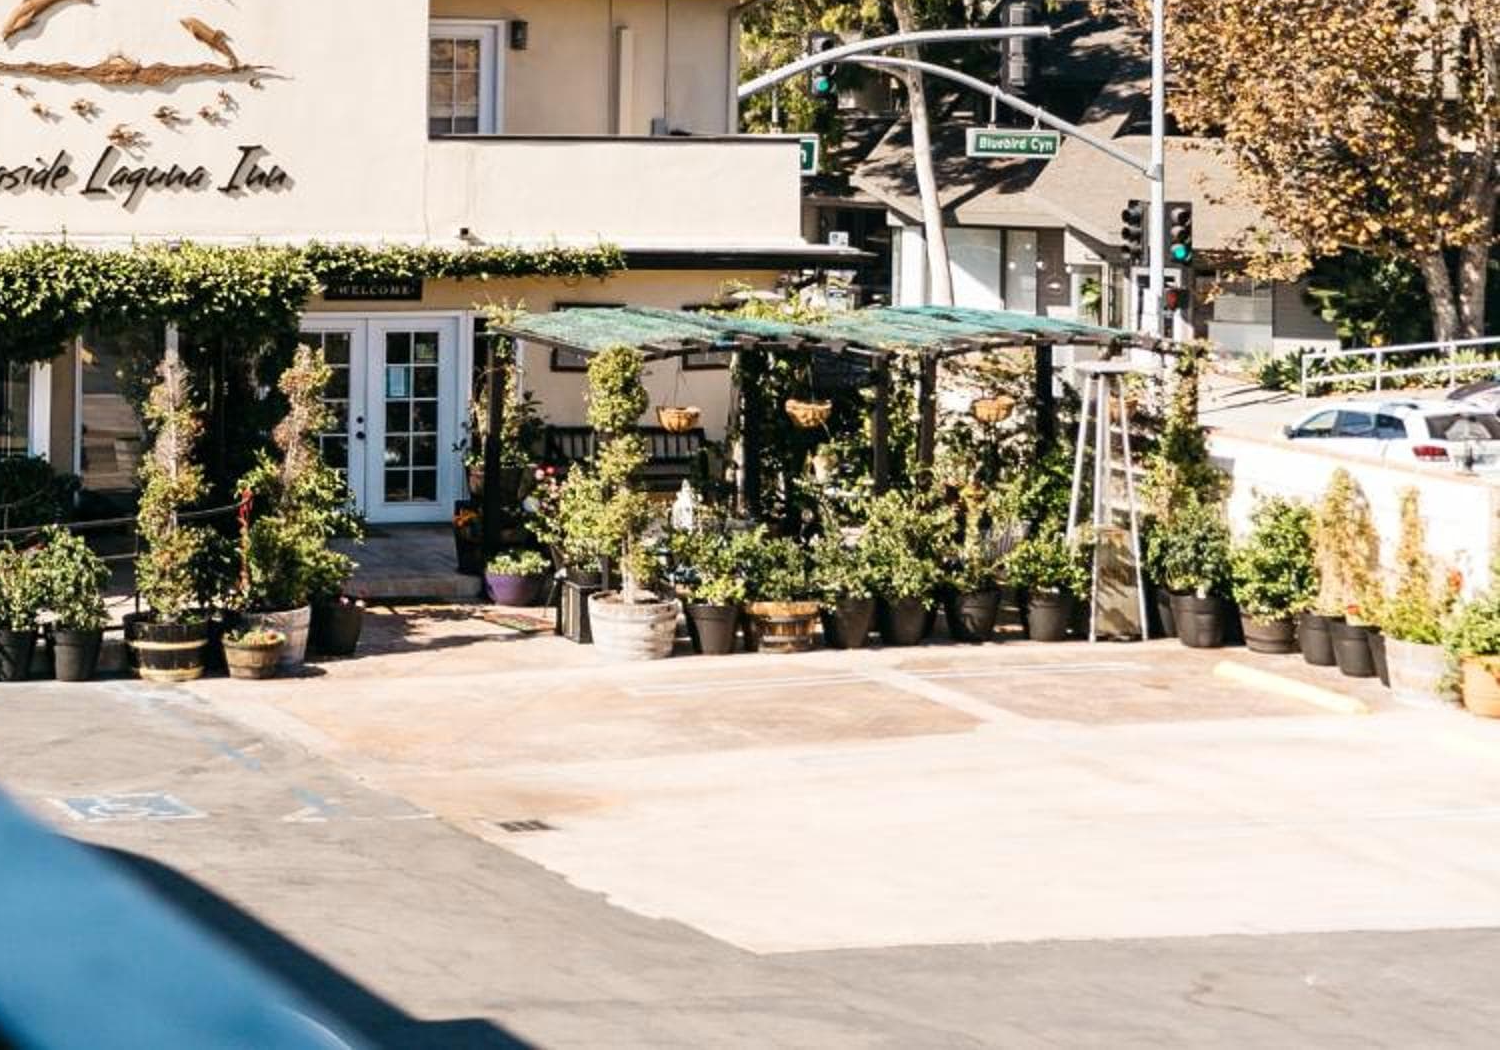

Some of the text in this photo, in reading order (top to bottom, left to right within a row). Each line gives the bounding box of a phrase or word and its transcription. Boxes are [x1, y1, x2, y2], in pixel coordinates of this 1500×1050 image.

[979, 136, 1053, 153] Bluebird Cyn
[79, 145, 206, 208] Laguna
[216, 144, 288, 192] Inn
[339, 285, 411, 295] WELCOME
